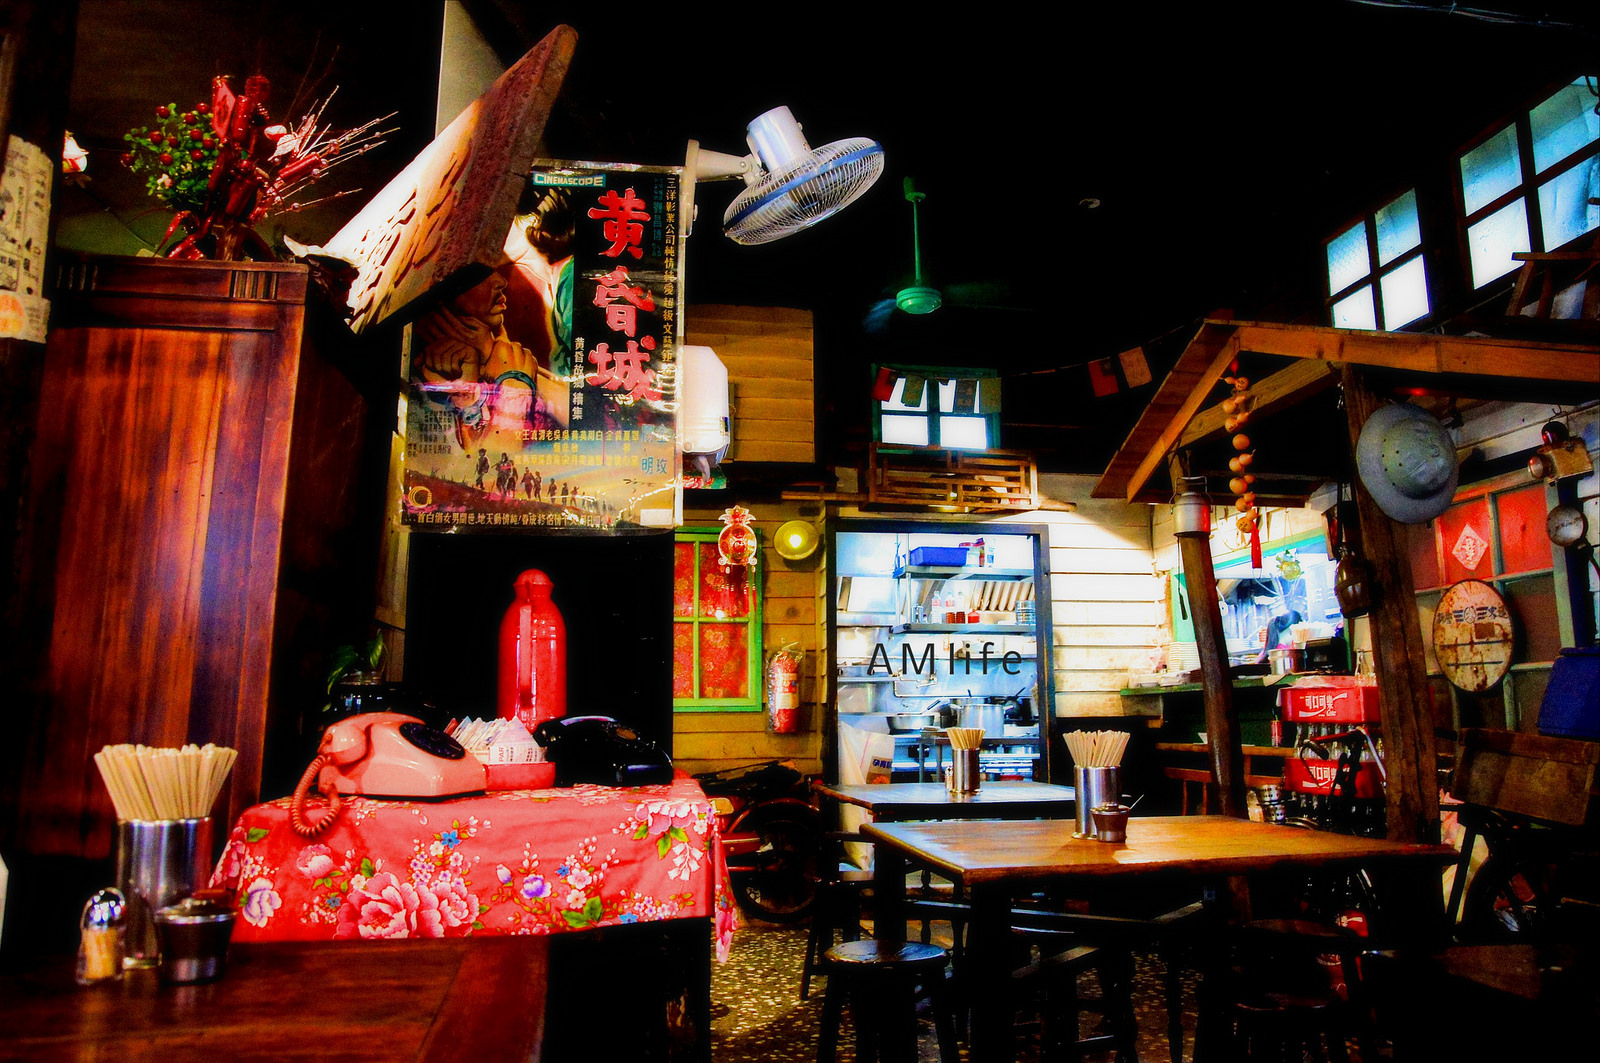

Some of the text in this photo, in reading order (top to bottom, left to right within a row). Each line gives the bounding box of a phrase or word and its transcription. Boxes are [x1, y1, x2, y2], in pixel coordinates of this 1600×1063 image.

[535, 173, 603, 186] CINEMASCOPE
[1305, 694, 1334, 710] 可口可樂
